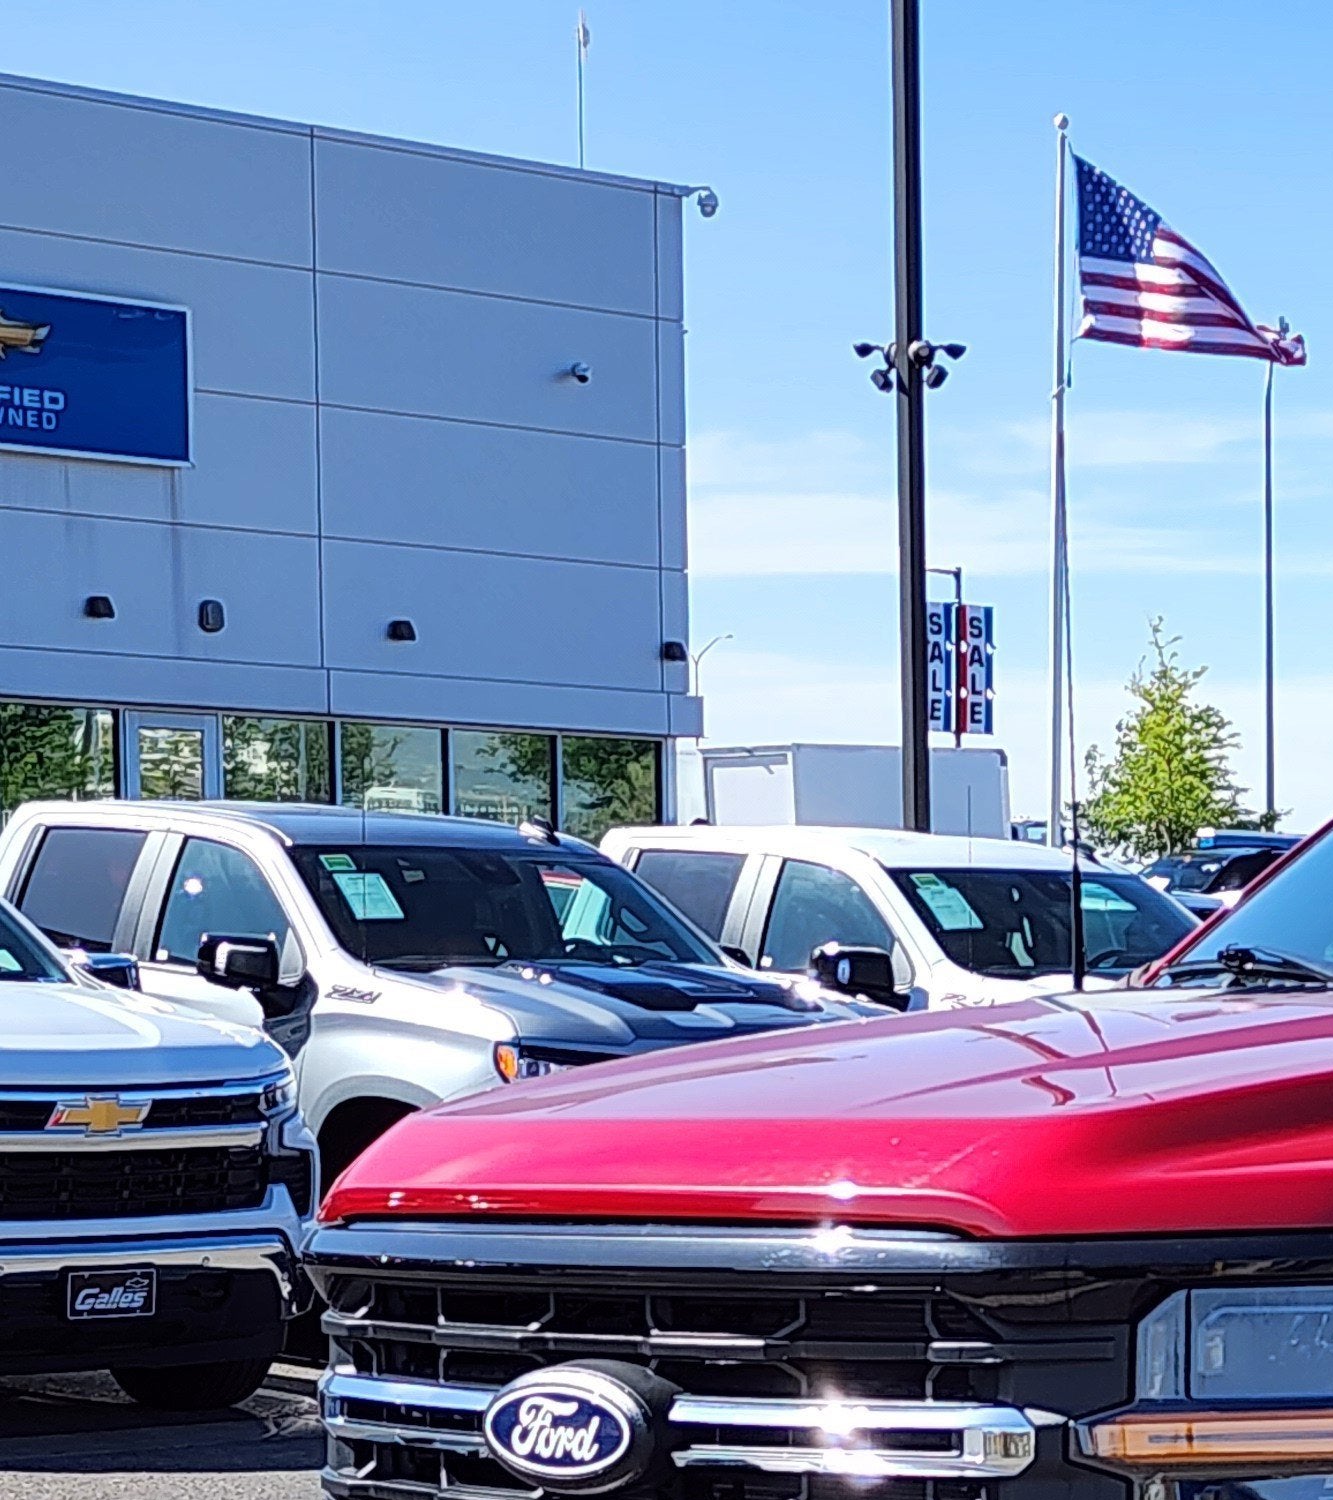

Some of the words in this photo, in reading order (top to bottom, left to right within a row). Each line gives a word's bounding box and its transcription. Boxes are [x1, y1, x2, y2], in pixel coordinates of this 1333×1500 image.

[928, 612, 944, 721] SALE
[968, 616, 985, 724] SALE
[75, 1286, 147, 1310] Galles
[511, 1396, 600, 1462] Ford
